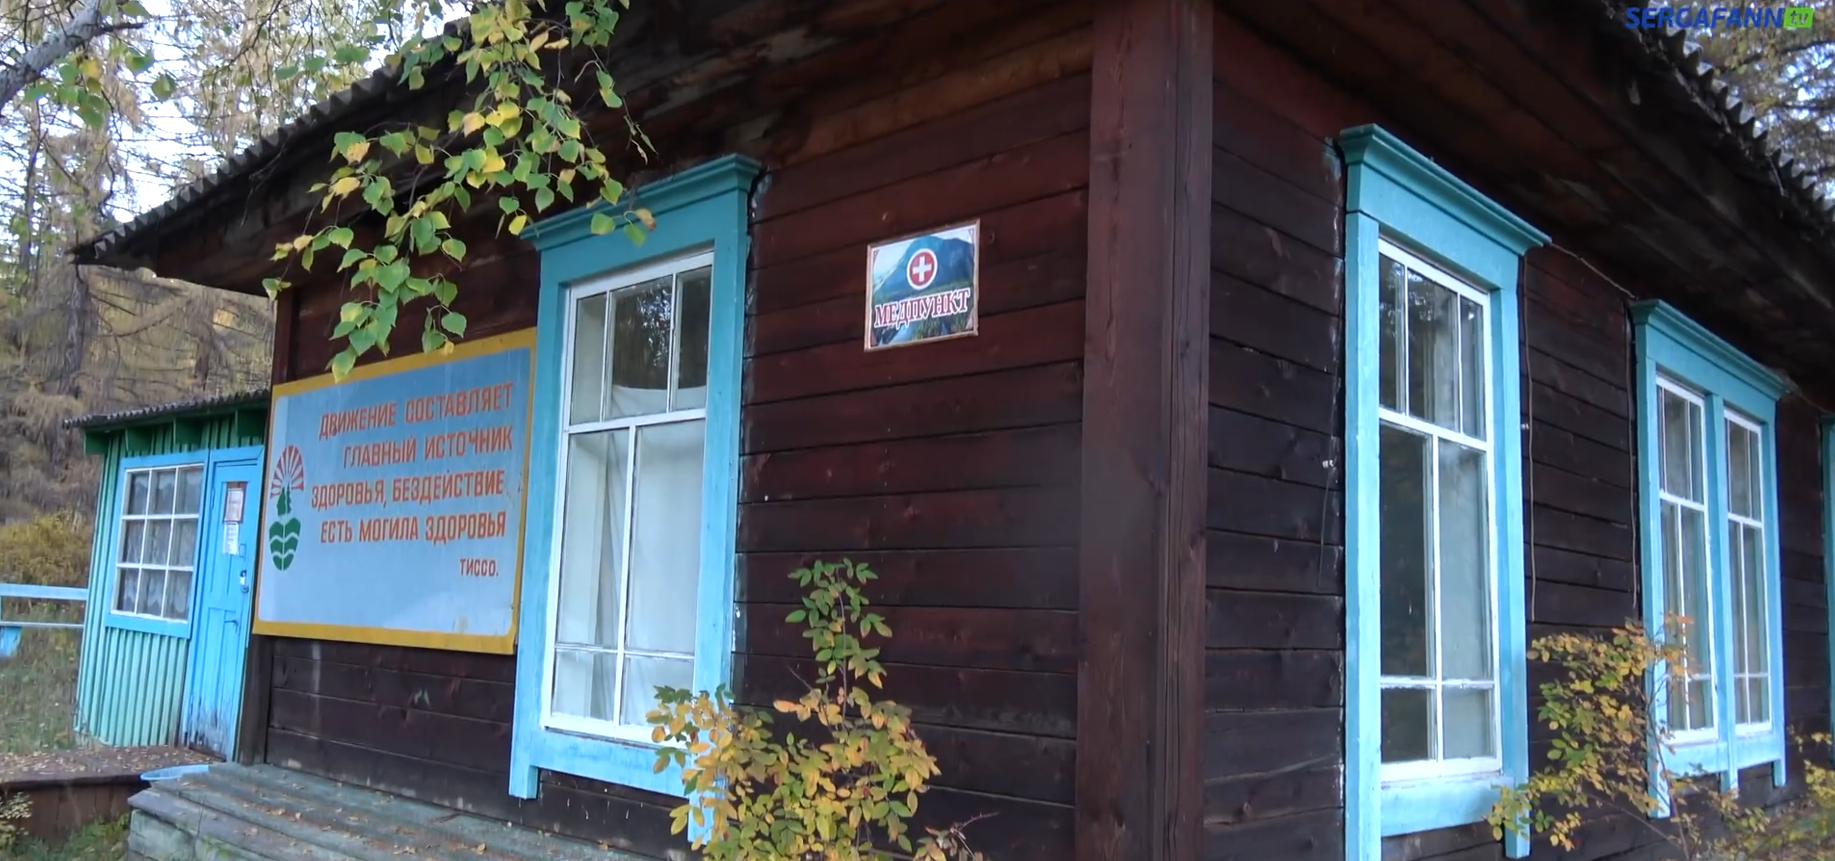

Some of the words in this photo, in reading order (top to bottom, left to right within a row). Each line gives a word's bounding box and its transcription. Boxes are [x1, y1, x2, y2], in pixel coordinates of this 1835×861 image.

[874, 287, 971, 330] МЕДПУНКТ
[319, 403, 398, 441] ДВИЖЕНИЕ
[405, 382, 515, 423] СОСТАВЛЯЕТ
[343, 434, 416, 468] ГЛАВНЫЙ
[424, 426, 513, 461] ИСТОЧНИК
[311, 479, 387, 512] ЗДОРОВЬЯ,
[392, 470, 505, 506] БЕЗДЕЙСТВИЕ
[320, 520, 353, 544] ЕСТЬ
[358, 516, 419, 542] МОГИЛА
[425, 511, 506, 546] ЗДОРОВЬЯ
[459, 558, 499, 577] ТИССО.
